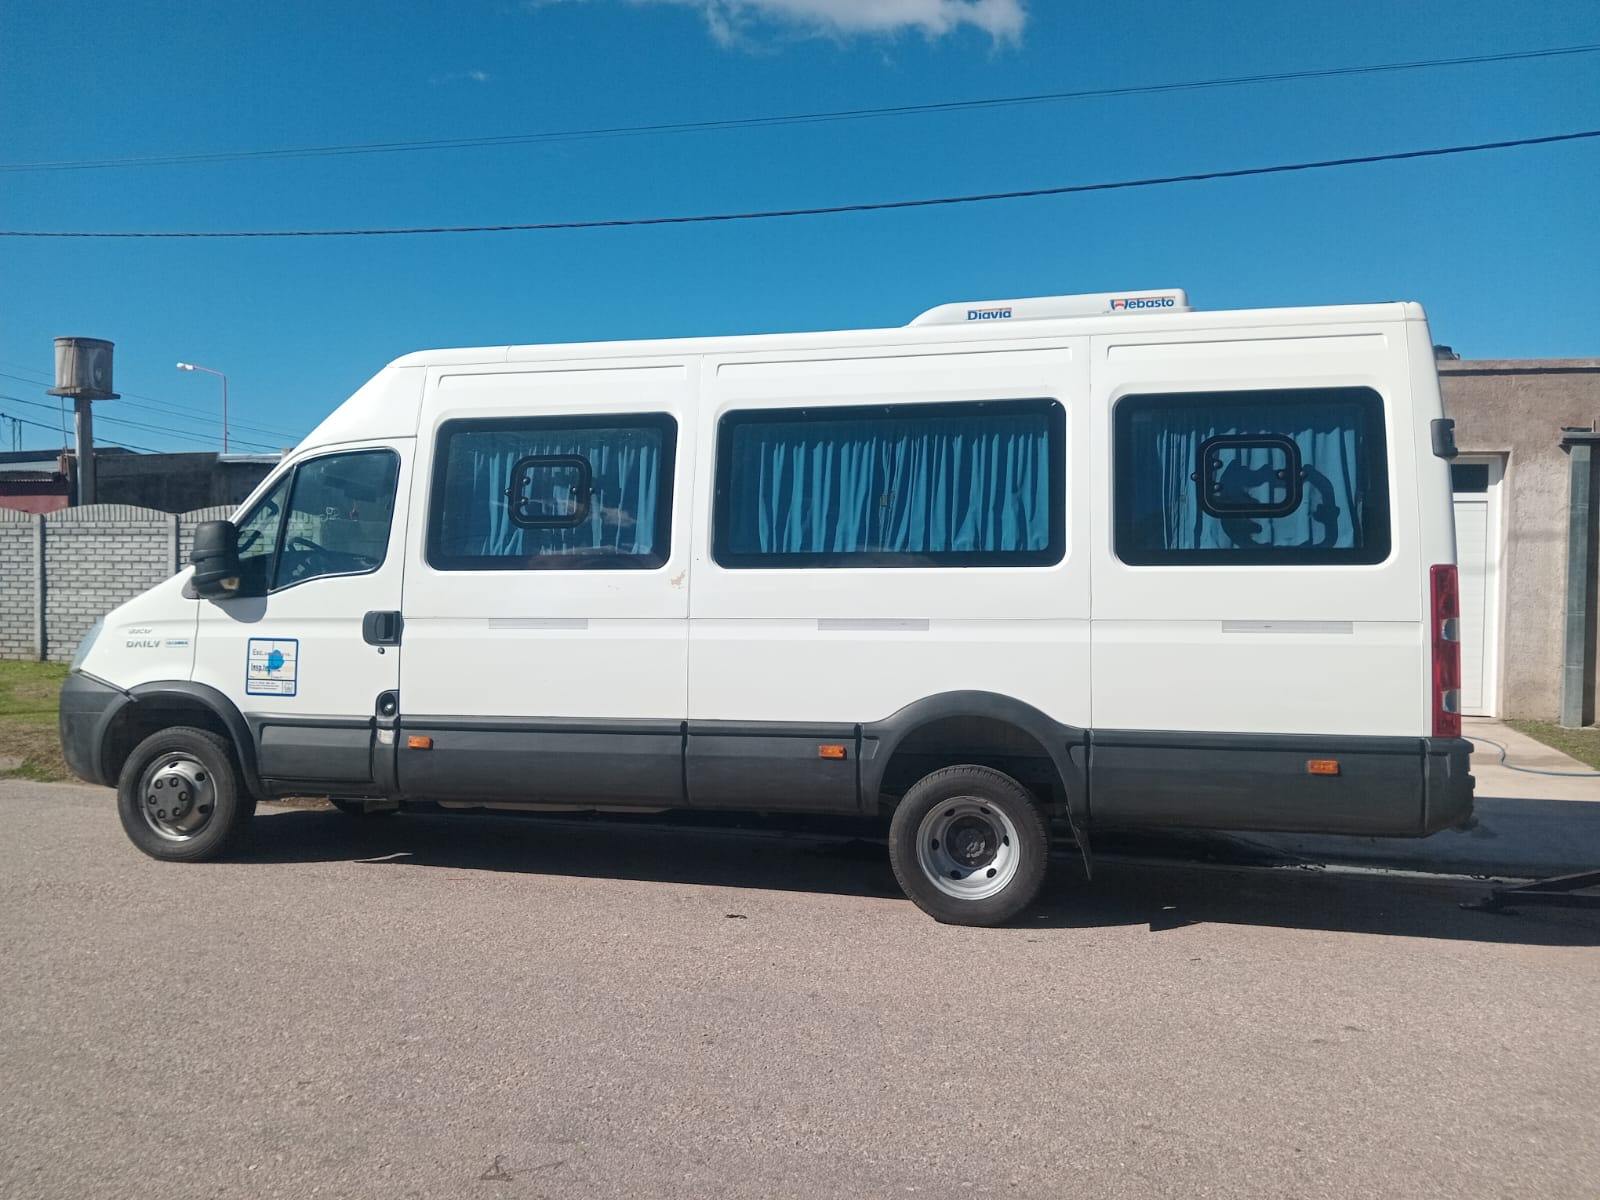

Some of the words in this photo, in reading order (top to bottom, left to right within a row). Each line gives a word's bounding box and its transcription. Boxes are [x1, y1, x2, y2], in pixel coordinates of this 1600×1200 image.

[1110, 297, 1175, 310] Webasto
[967, 308, 1012, 321] Diavia
[126, 640, 160, 649] DAILY
